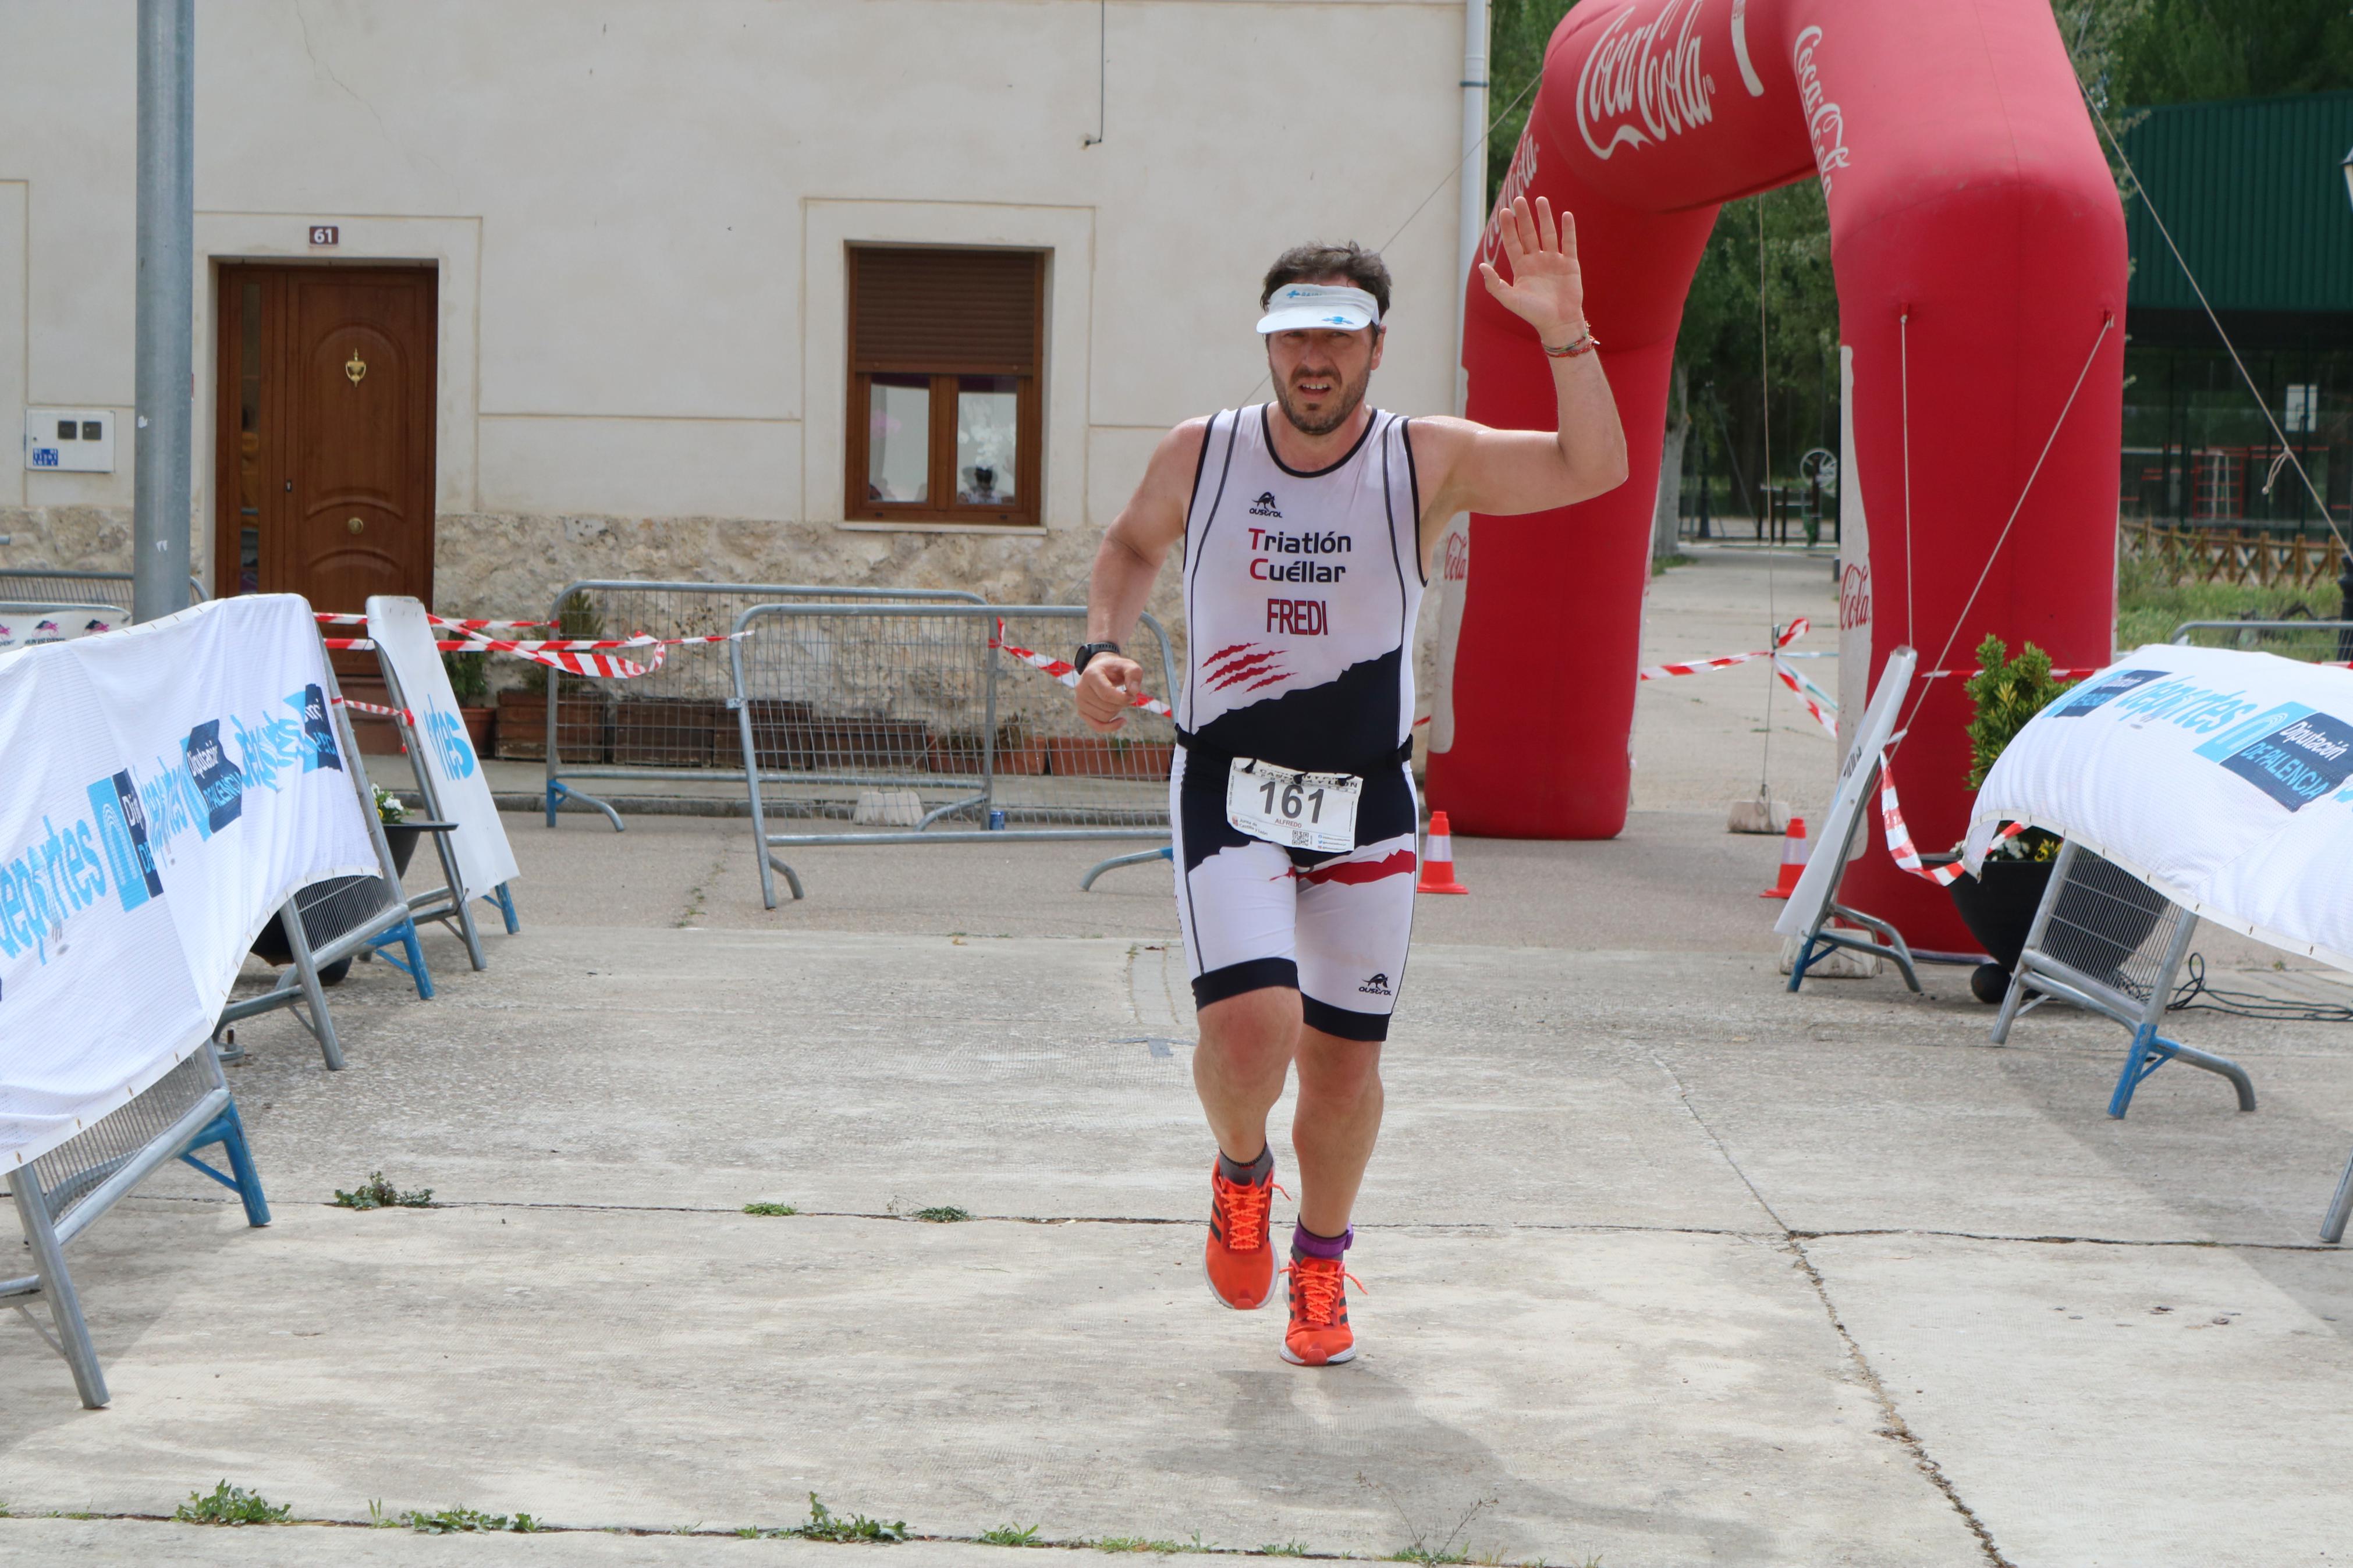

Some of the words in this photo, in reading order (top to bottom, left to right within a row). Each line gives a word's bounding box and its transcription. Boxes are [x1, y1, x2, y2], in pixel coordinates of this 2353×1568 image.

[314, 228, 332, 243] 61
[1248, 528, 1351, 554] Triatlón
[1250, 558, 1346, 583] Cuéllar
[1266, 598, 1328, 635] FREDI
[2279, 721, 2350, 761] Diputación
[1259, 781, 1325, 824] 161
[1275, 818, 1302, 829] ALFREDO
